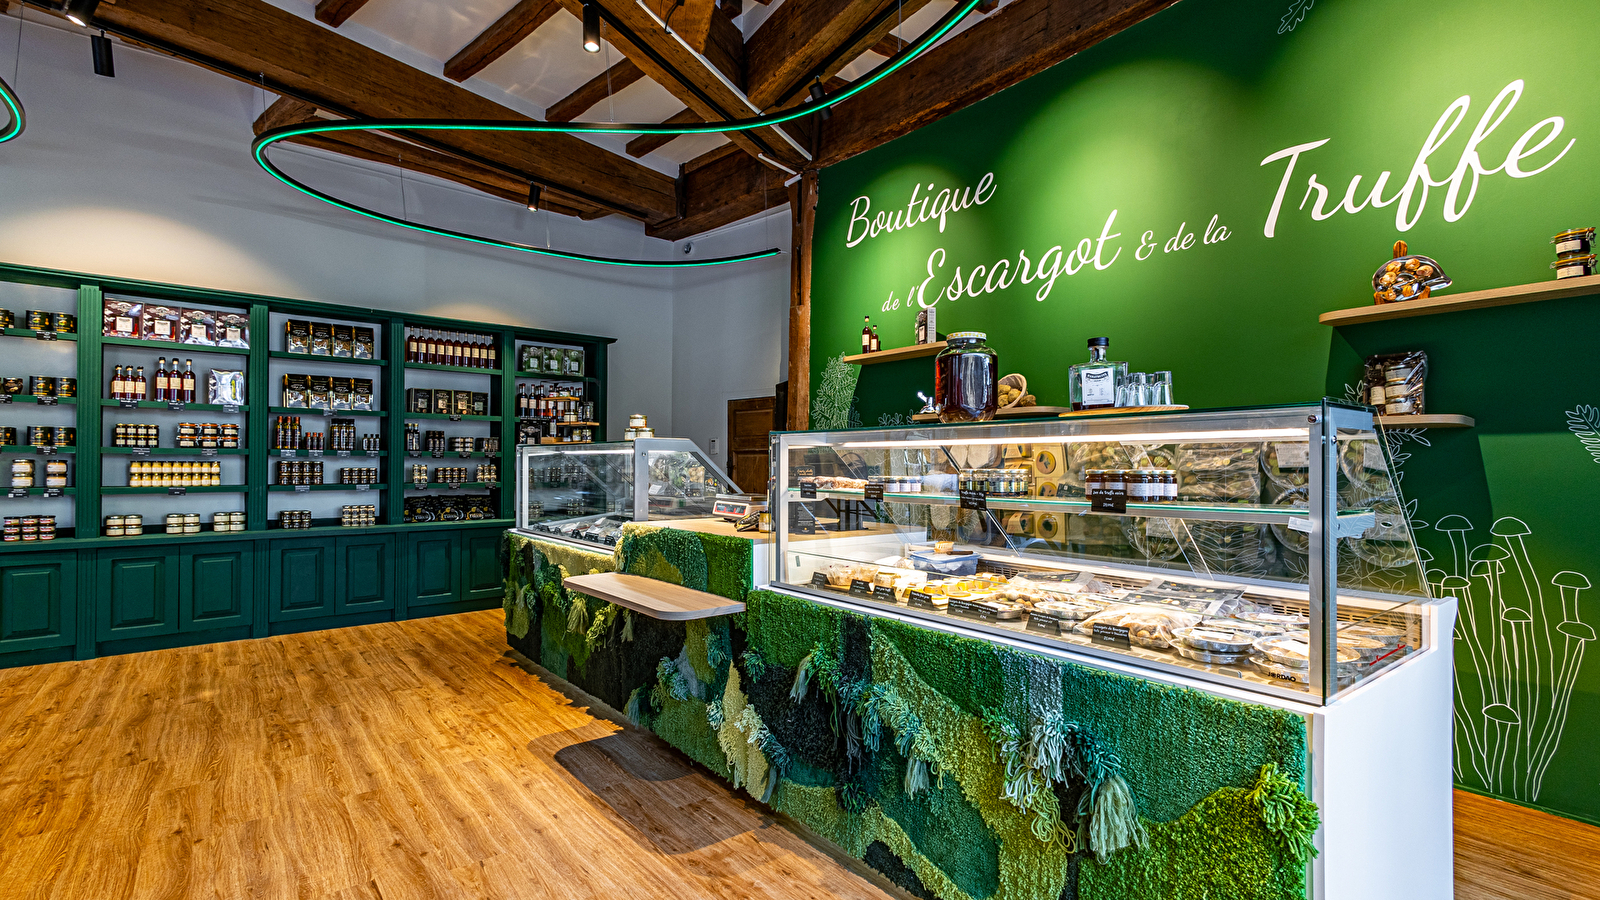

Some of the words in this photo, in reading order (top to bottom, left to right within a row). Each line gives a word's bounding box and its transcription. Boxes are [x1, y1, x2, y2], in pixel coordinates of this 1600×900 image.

[846, 172, 997, 249] Boutique
[881, 290, 901, 313] de
[1135, 229, 1158, 261] &
[1163, 221, 1196, 254] de
[1203, 213, 1232, 245] la
[1260, 78, 1577, 239] Truffe
